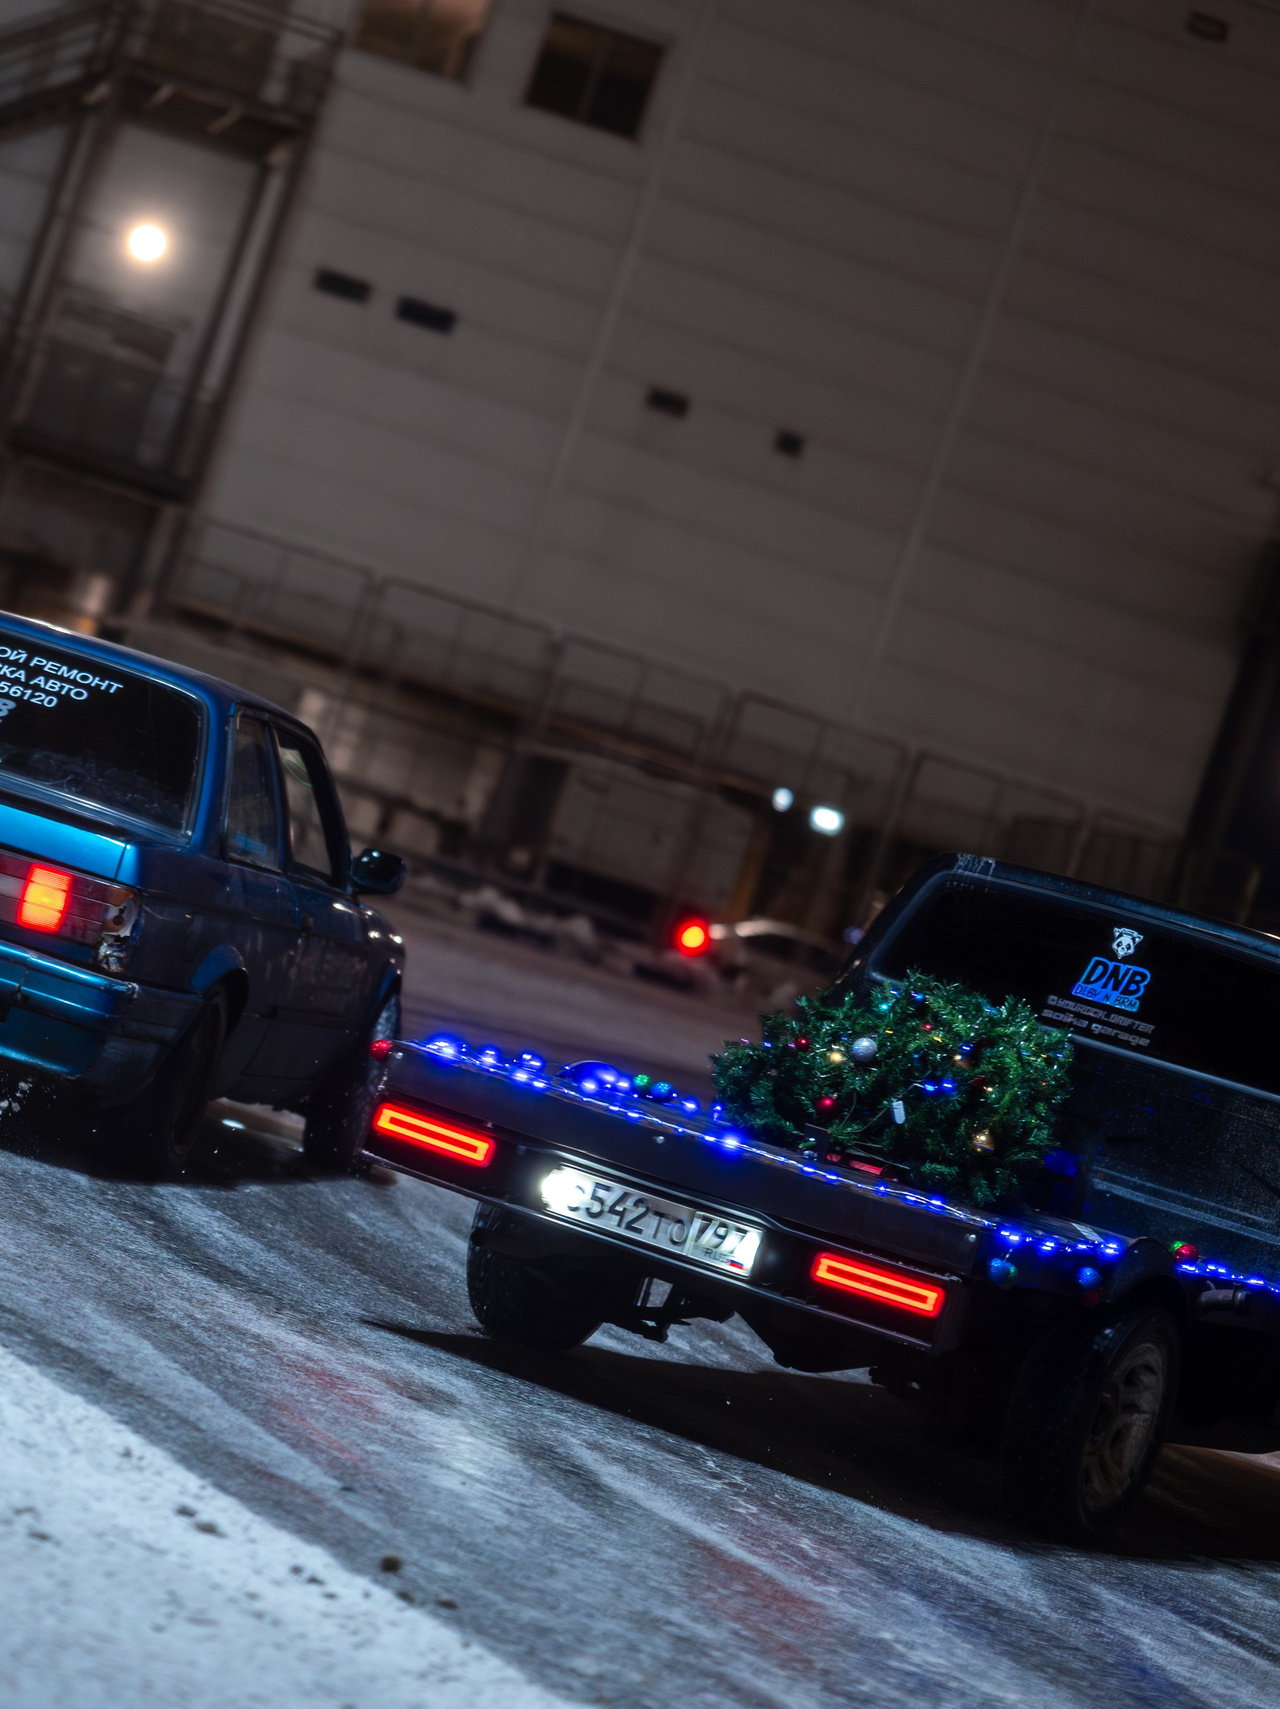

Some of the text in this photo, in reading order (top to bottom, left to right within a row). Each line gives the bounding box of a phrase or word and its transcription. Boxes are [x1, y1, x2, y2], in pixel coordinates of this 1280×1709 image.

[29, 657, 124, 694] РЕМОНТ
[29, 675, 89, 701] АВТО
[1081, 957, 1151, 998] DNB
[1091, 1022, 1151, 1047] garage
